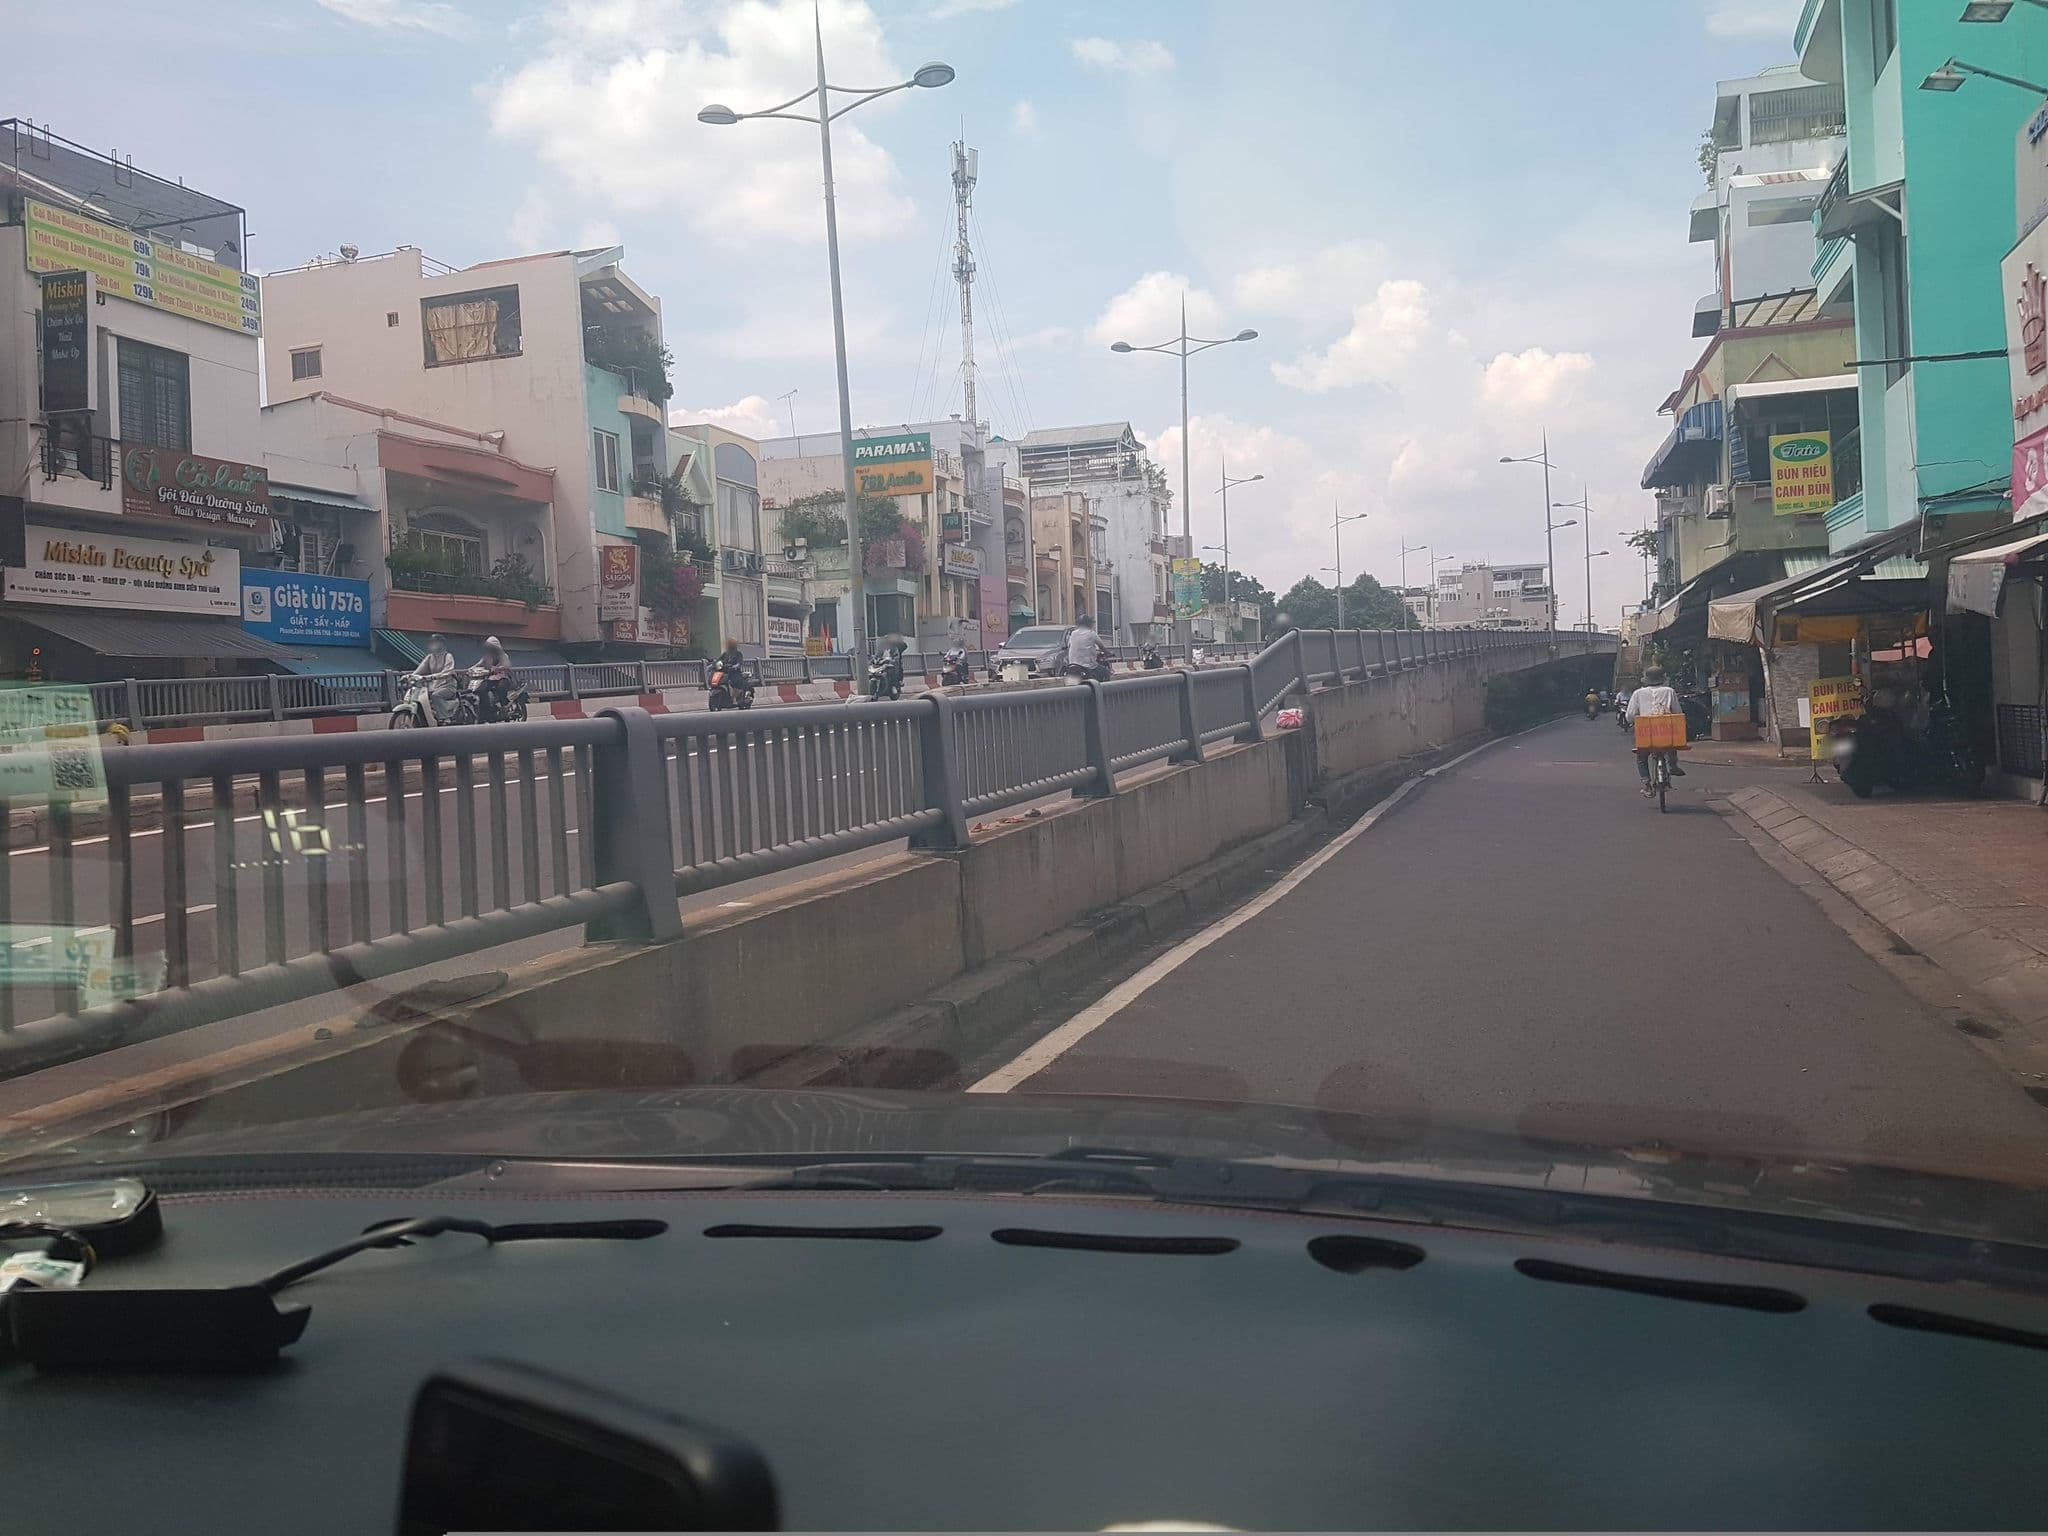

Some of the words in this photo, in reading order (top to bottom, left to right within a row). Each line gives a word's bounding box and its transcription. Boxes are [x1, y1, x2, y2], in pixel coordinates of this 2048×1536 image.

[134, 240, 150, 256] 69k
[135, 262, 150, 278] 79k
[47, 280, 84, 298] Miskin
[134, 284, 154, 300] 129k
[1776, 466, 1799, 480] BÚN
[1802, 464, 1826, 478] RIÊU
[1776, 484, 1804, 498] CANH
[1808, 481, 1830, 496] BÚN
[158, 486, 178, 503] Gội
[180, 489, 205, 506] Đầu
[205, 494, 242, 514] Dưỡng
[244, 500, 269, 516] Sinh
[174, 505, 194, 518] Nails
[196, 509, 220, 523] Design
[226, 512, 256, 528] Massage
[44, 540, 107, 568] Miskin
[112, 548, 174, 579] Beauty
[180, 556, 210, 580] Spa
[274, 584, 308, 614] Giặt
[312, 586, 326, 610] ủi
[329, 590, 363, 612] 757a
[619, 592, 630, 600] 759
[290, 614, 308, 628] GIẶT
[314, 614, 330, 627] SẤY
[1812, 700, 1840, 714] CANH
